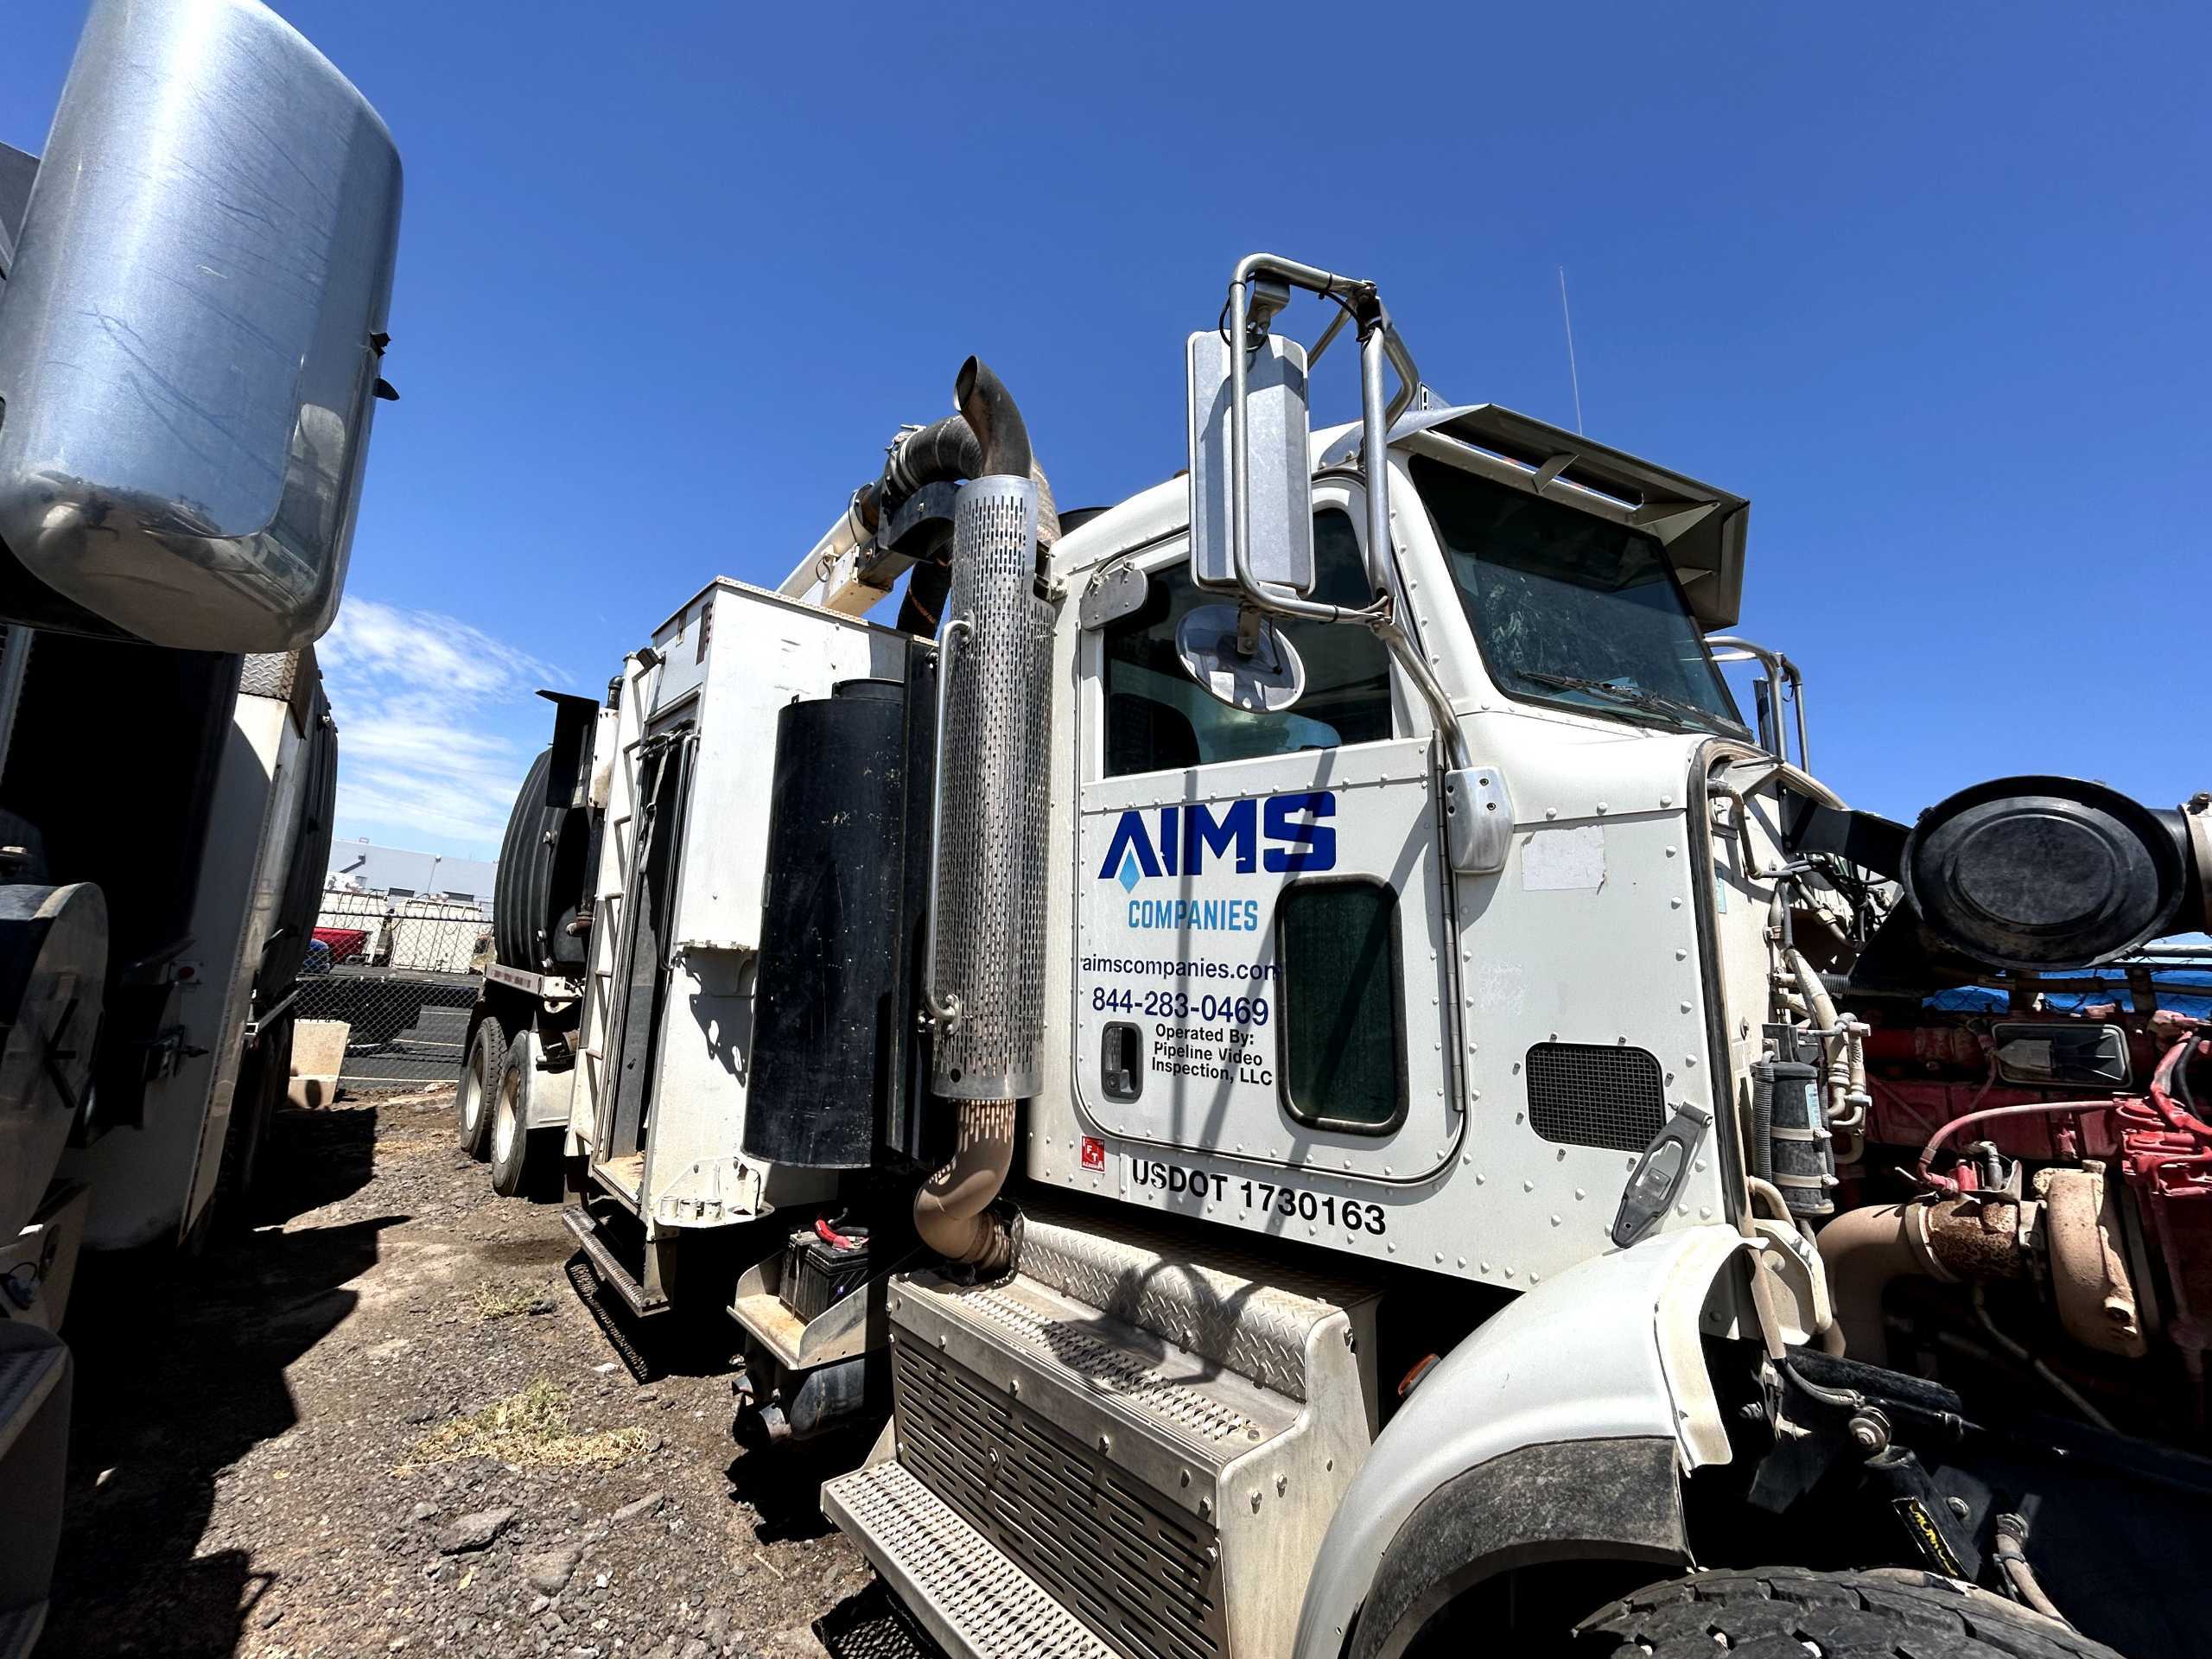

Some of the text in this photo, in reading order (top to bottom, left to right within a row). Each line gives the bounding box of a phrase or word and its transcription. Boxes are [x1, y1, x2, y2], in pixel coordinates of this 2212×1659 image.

[1097, 791, 1336, 880] AIMS
[1128, 899, 1258, 931] COMPANIES
[1092, 987, 1269, 1026] 844-283-0469
[1156, 1023, 1255, 1047] Operated By:
[1154, 1041, 1262, 1066] Pipeline Video
[1152, 1057, 1273, 1086] Inspection, LLC
[1132, 1159, 1387, 1236] USDOT 1730163
